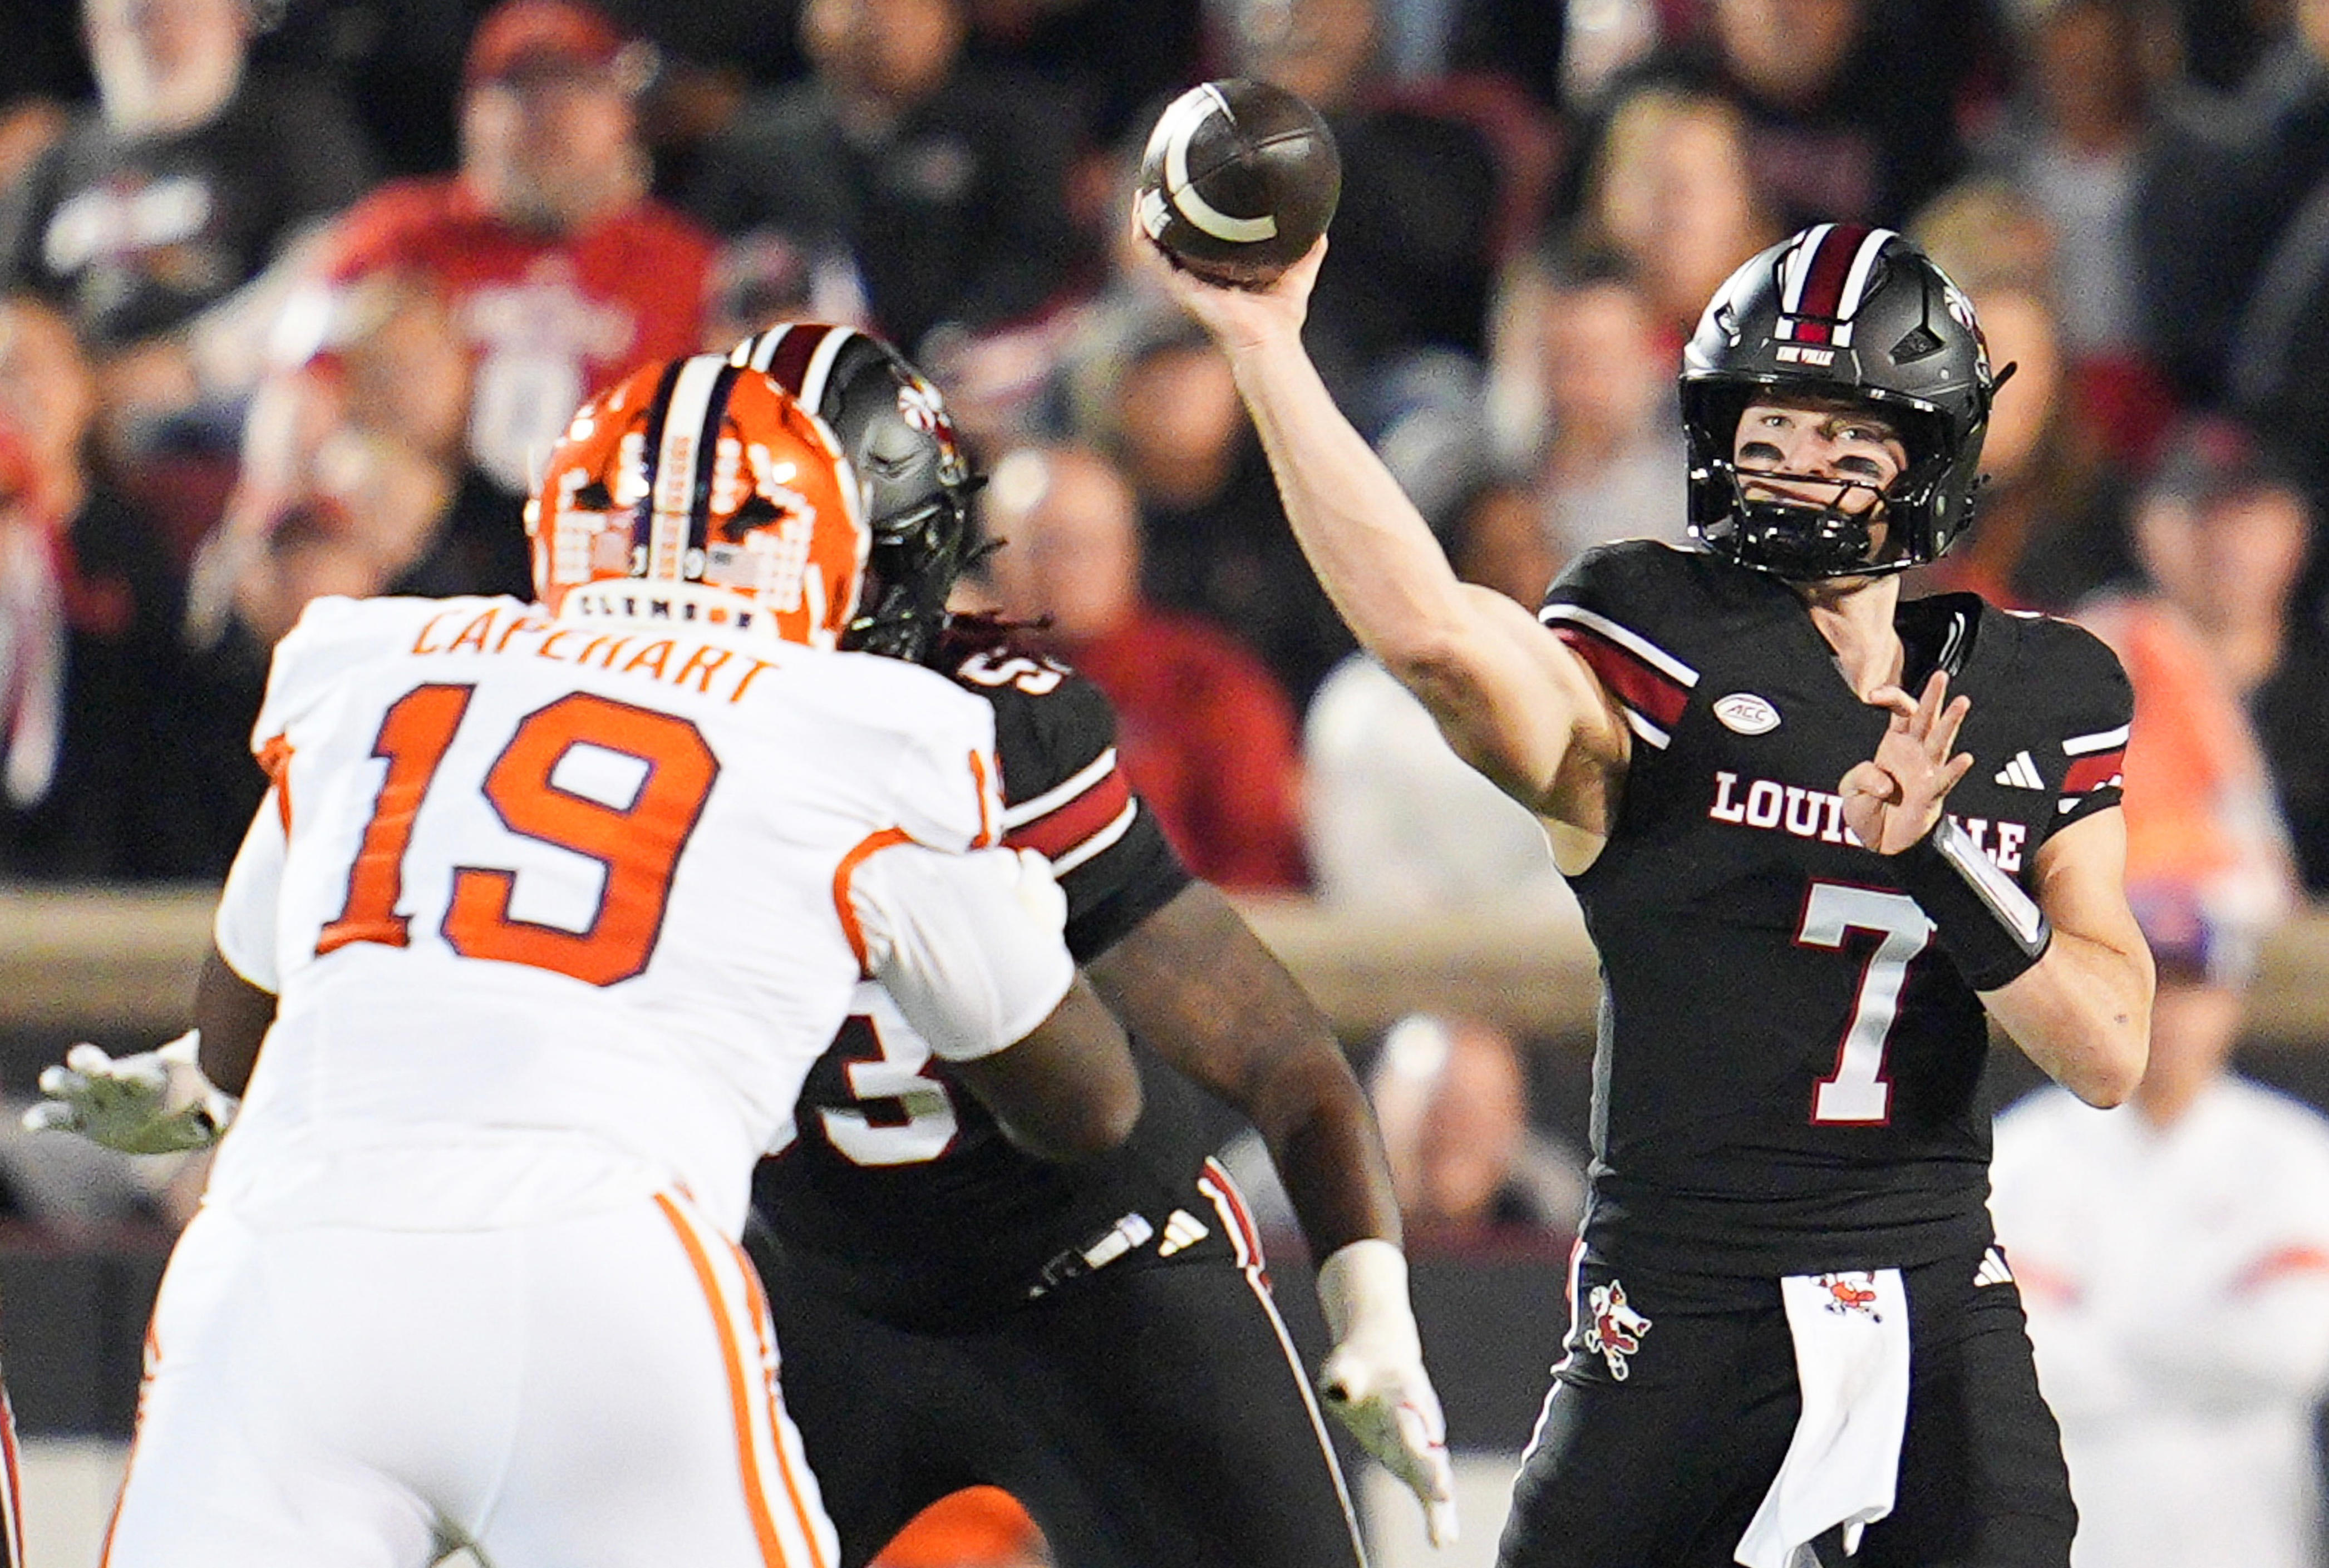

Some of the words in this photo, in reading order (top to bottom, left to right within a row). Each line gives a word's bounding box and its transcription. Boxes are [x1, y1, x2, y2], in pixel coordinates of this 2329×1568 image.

[1726, 704, 1767, 722] ACC
[314, 682, 721, 988] 19
[1710, 771, 2027, 871] LOUILE
[762, 981, 958, 1166] 3
[1795, 879, 1936, 1126] 7
